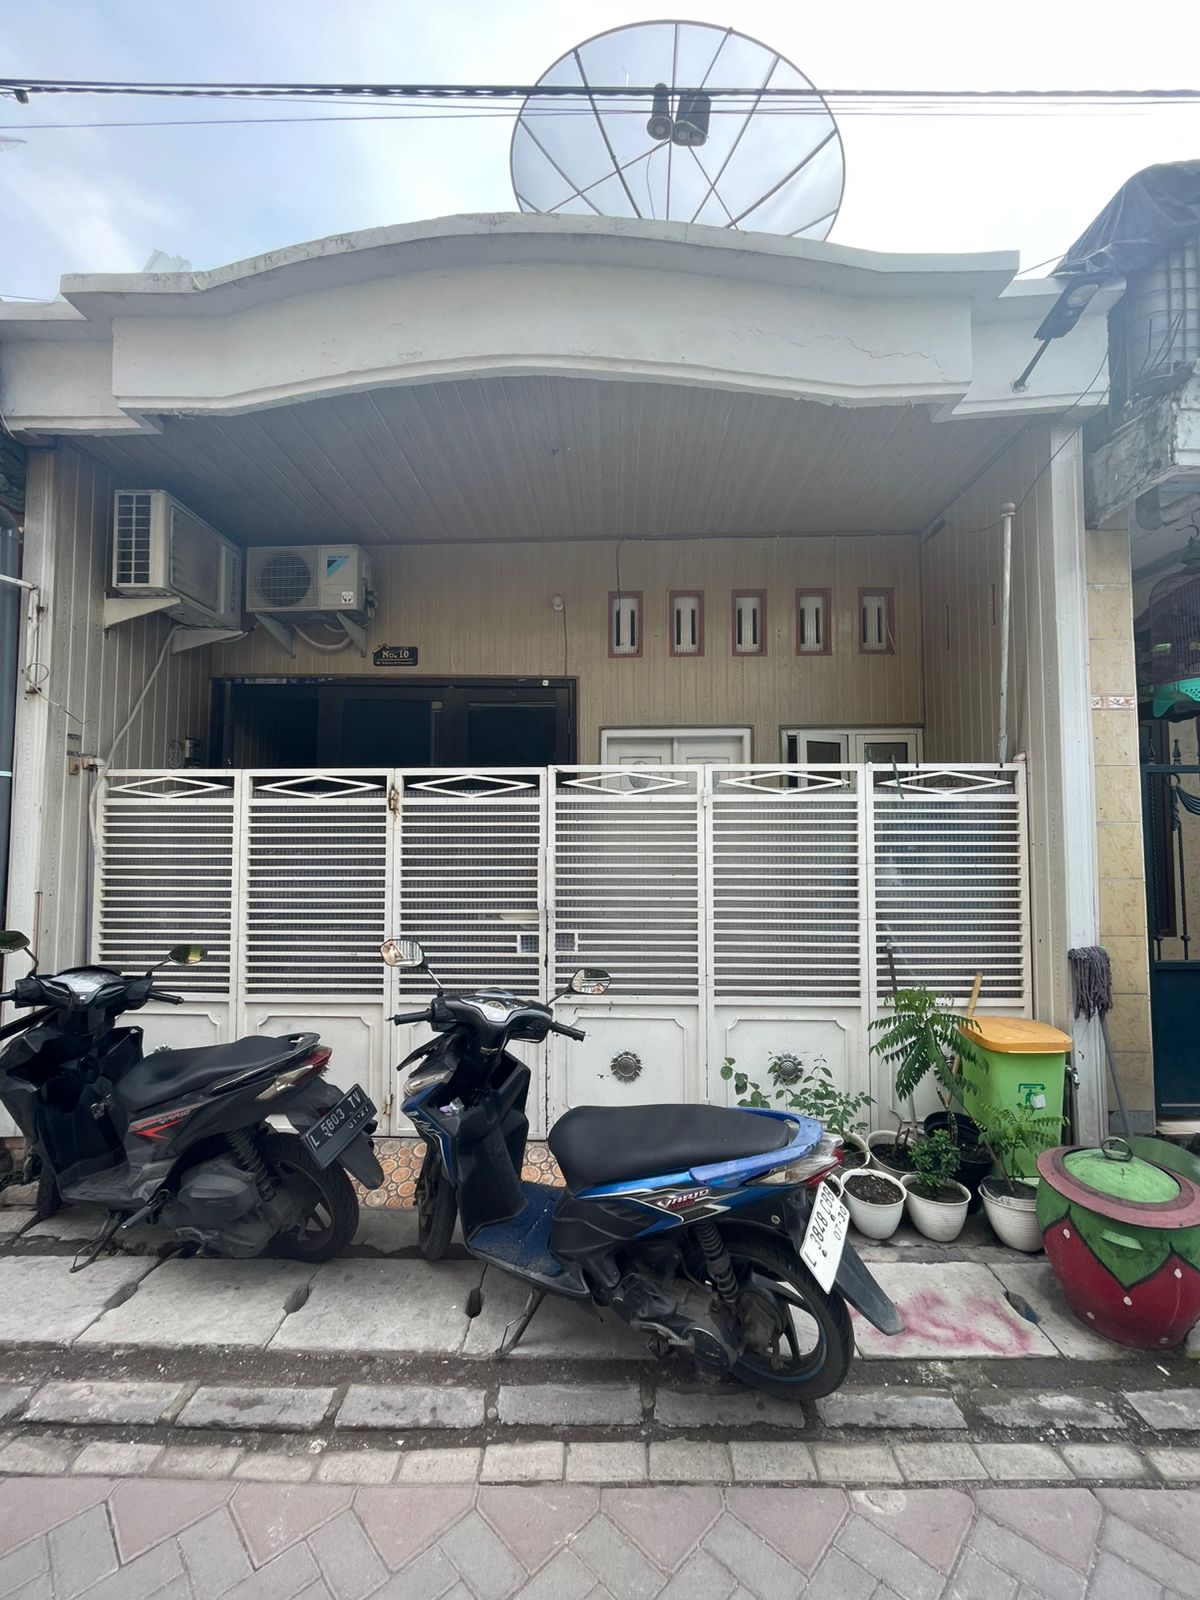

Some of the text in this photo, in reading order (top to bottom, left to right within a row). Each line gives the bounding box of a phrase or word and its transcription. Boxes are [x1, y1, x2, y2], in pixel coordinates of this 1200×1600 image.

[382, 649, 409, 659] No. 10
[309, 1134, 320, 1147] L
[347, 1090, 361, 1108] TV
[810, 1211, 829, 1250] 3848
[804, 1250, 817, 1268] L
